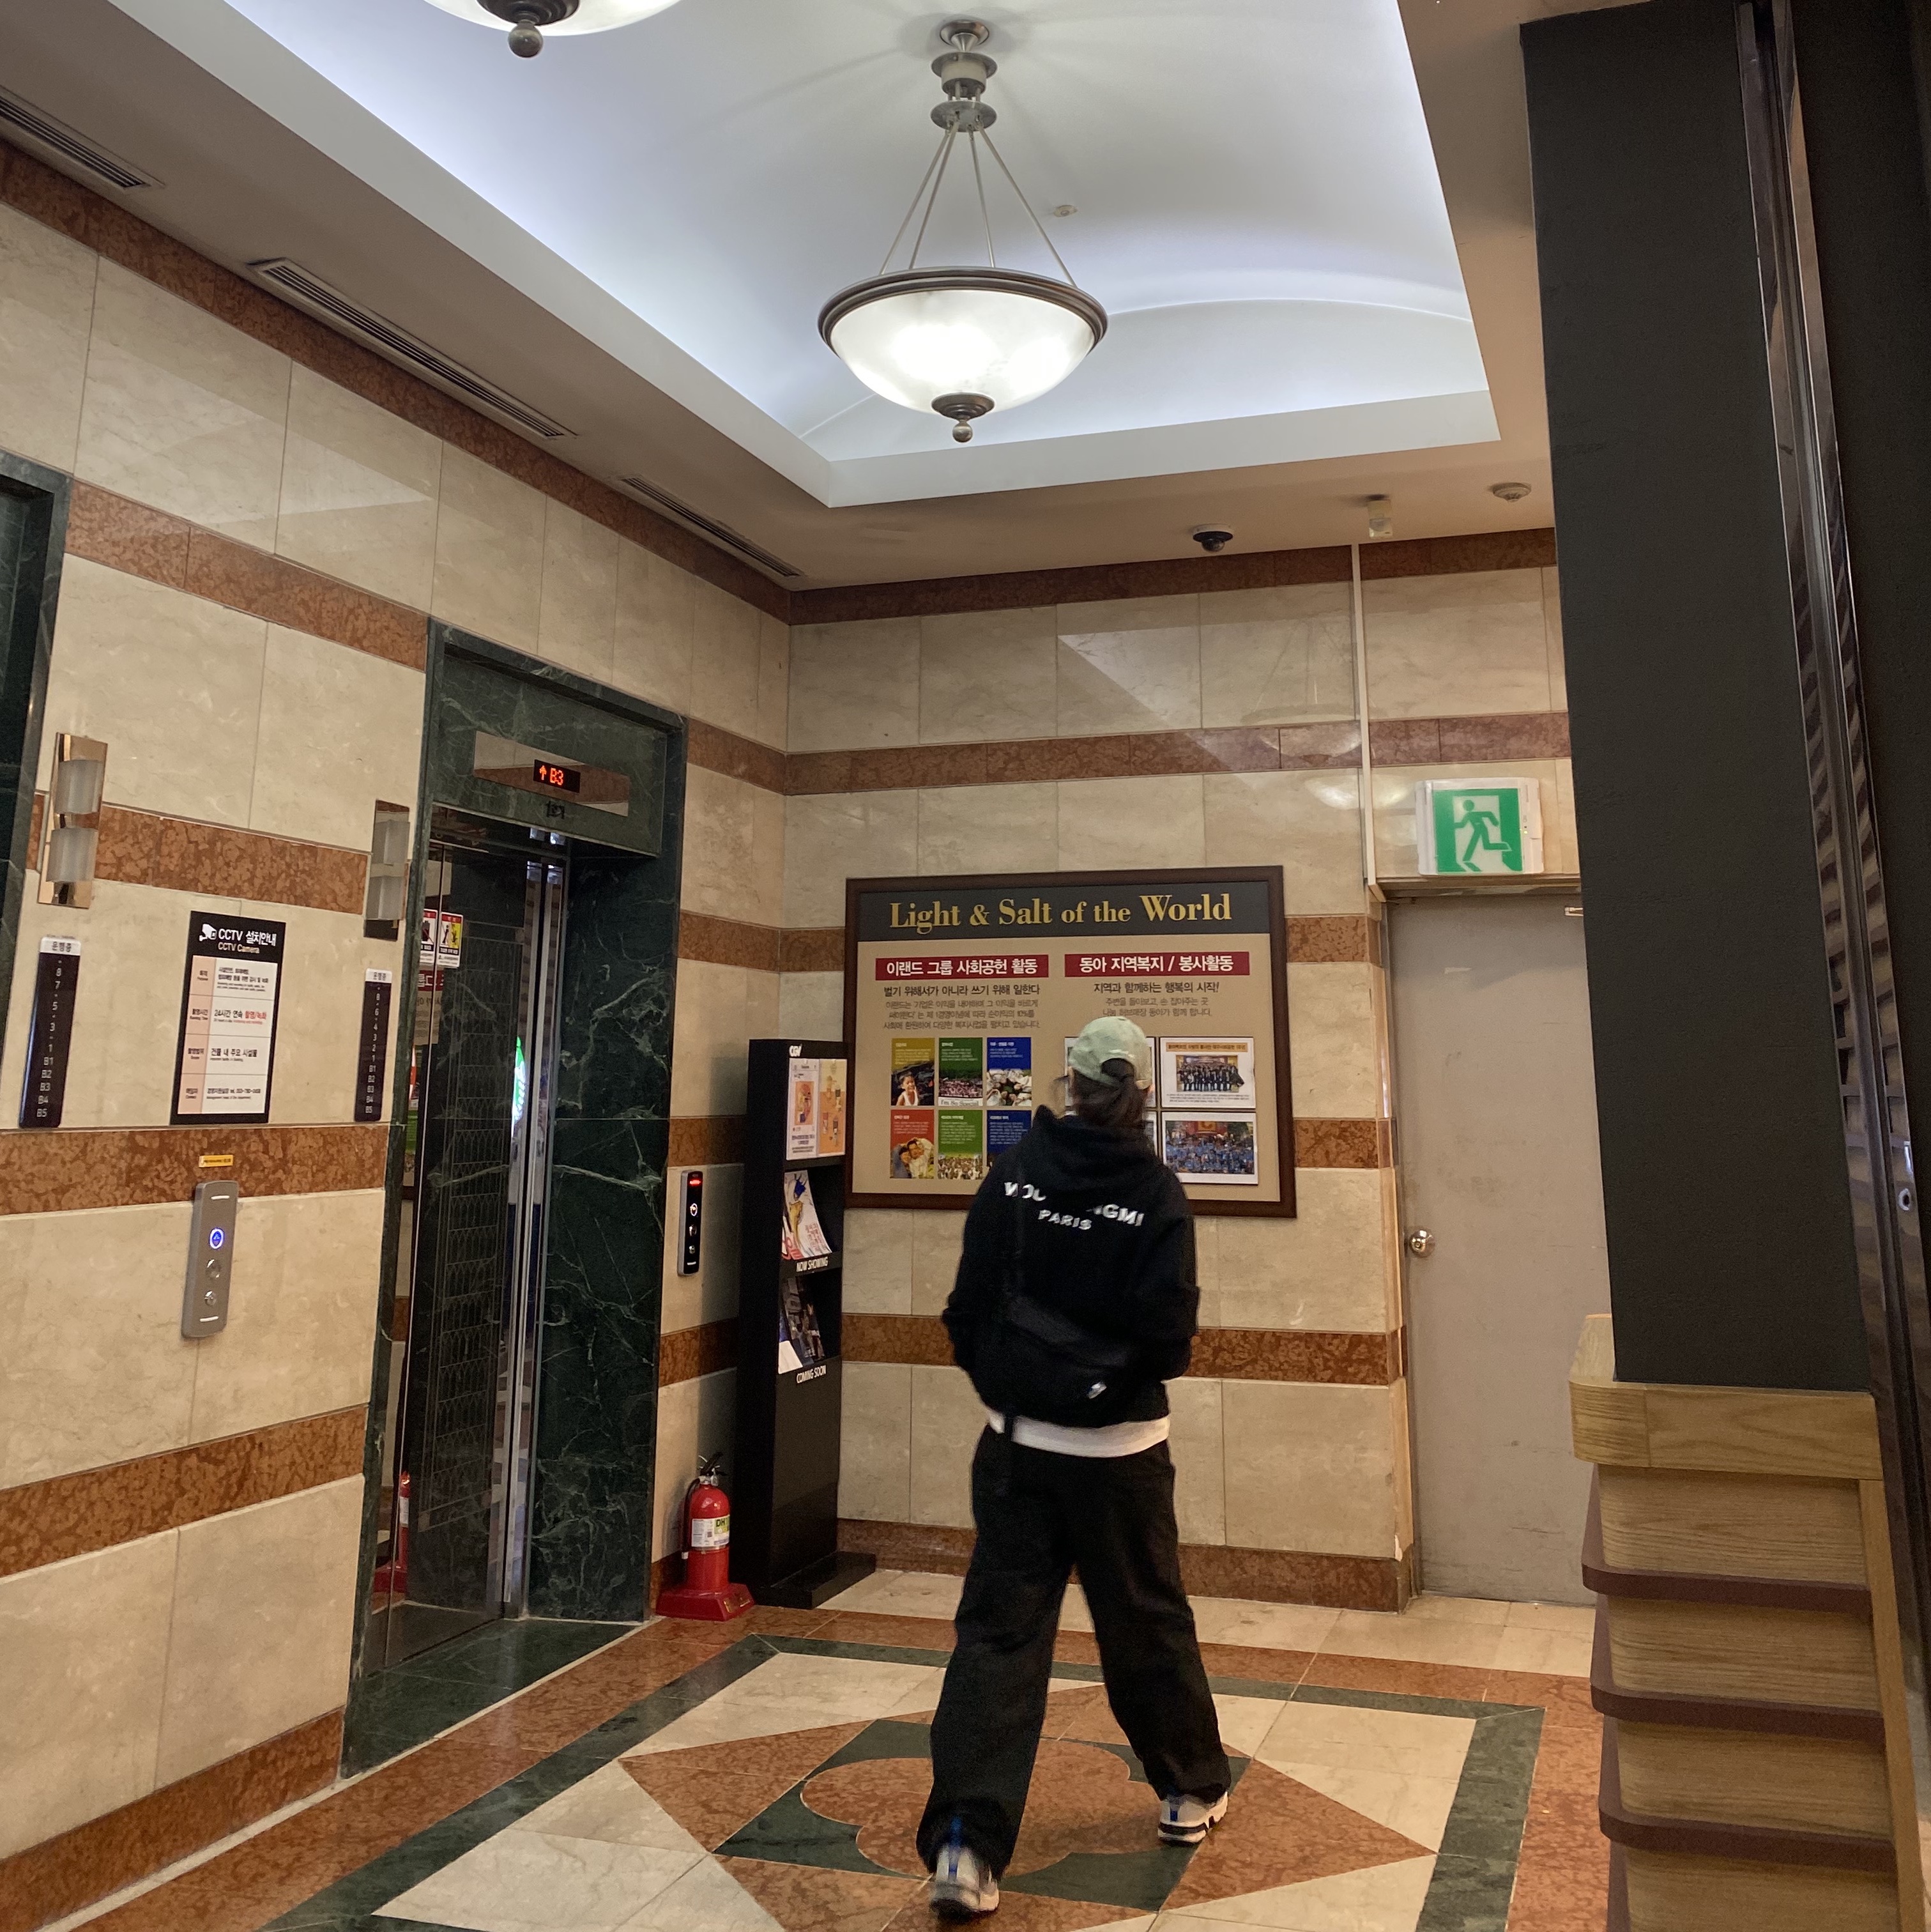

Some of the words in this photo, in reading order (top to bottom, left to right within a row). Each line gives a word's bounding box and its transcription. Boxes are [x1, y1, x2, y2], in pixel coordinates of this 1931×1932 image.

[550, 767, 564, 786] B3
[890, 901, 961, 935] Light
[970, 905, 989, 926] &
[998, 898, 1053, 924] Salt
[1060, 901, 1087, 923] of
[1093, 901, 1131, 922] the
[1139, 893, 1232, 921] World
[218, 928, 243, 941] CCTV
[245, 930, 277, 947] 설치안내
[218, 942, 236, 951] CCTV
[237, 944, 260, 954] Camera
[887, 962, 924, 976] 이랜드
[927, 960, 952, 976] 그룹
[956, 958, 1007, 975] 사회공헌
[1011, 958, 1038, 975] 활동
[1080, 956, 1107, 973] 동아
[1111, 956, 1164, 972] 지역복지
[1168, 956, 1175, 972] /
[1179, 954, 1234, 972] 봉사활동
[56, 968, 62, 977] 8
[55, 981, 61, 990] 7
[1094, 983, 1121, 994] 지역과
[1125, 982, 1162, 993] 함께하는
[1165, 982, 1193, 993] 행복의
[1196, 981, 1219, 993] 시작!
[884, 986, 901, 997] 벌기
[904, 985, 939, 997] 위해서가
[942, 985, 968, 996] 아니라
[971, 985, 989, 995] 쓰기
[993, 985, 1011, 995] 위해
[1013, 984, 1040, 995] 일한다
[52, 1002, 58, 1010] 5
[50, 1022, 56, 1032] 3
[373, 1023, 378, 1031] 4
[372, 1033, 377, 1041] 3
[48, 1044, 53, 1052] 1
[43, 1056, 54, 1065] B1
[41, 1069, 52, 1078] B2
[40, 1082, 50, 1091] B3
[38, 1095, 49, 1104] B4
[366, 1095, 374, 1103] B4
[36, 1108, 47, 1117] B5
[365, 1105, 372, 1114] B5
[1038, 1209, 1092, 1230] PARIS
[796, 1261, 807, 1272] NOW
[807, 1256, 828, 1270] SHOWING
[796, 1368, 814, 1384] COMING
[814, 1364, 827, 1378] SOON
